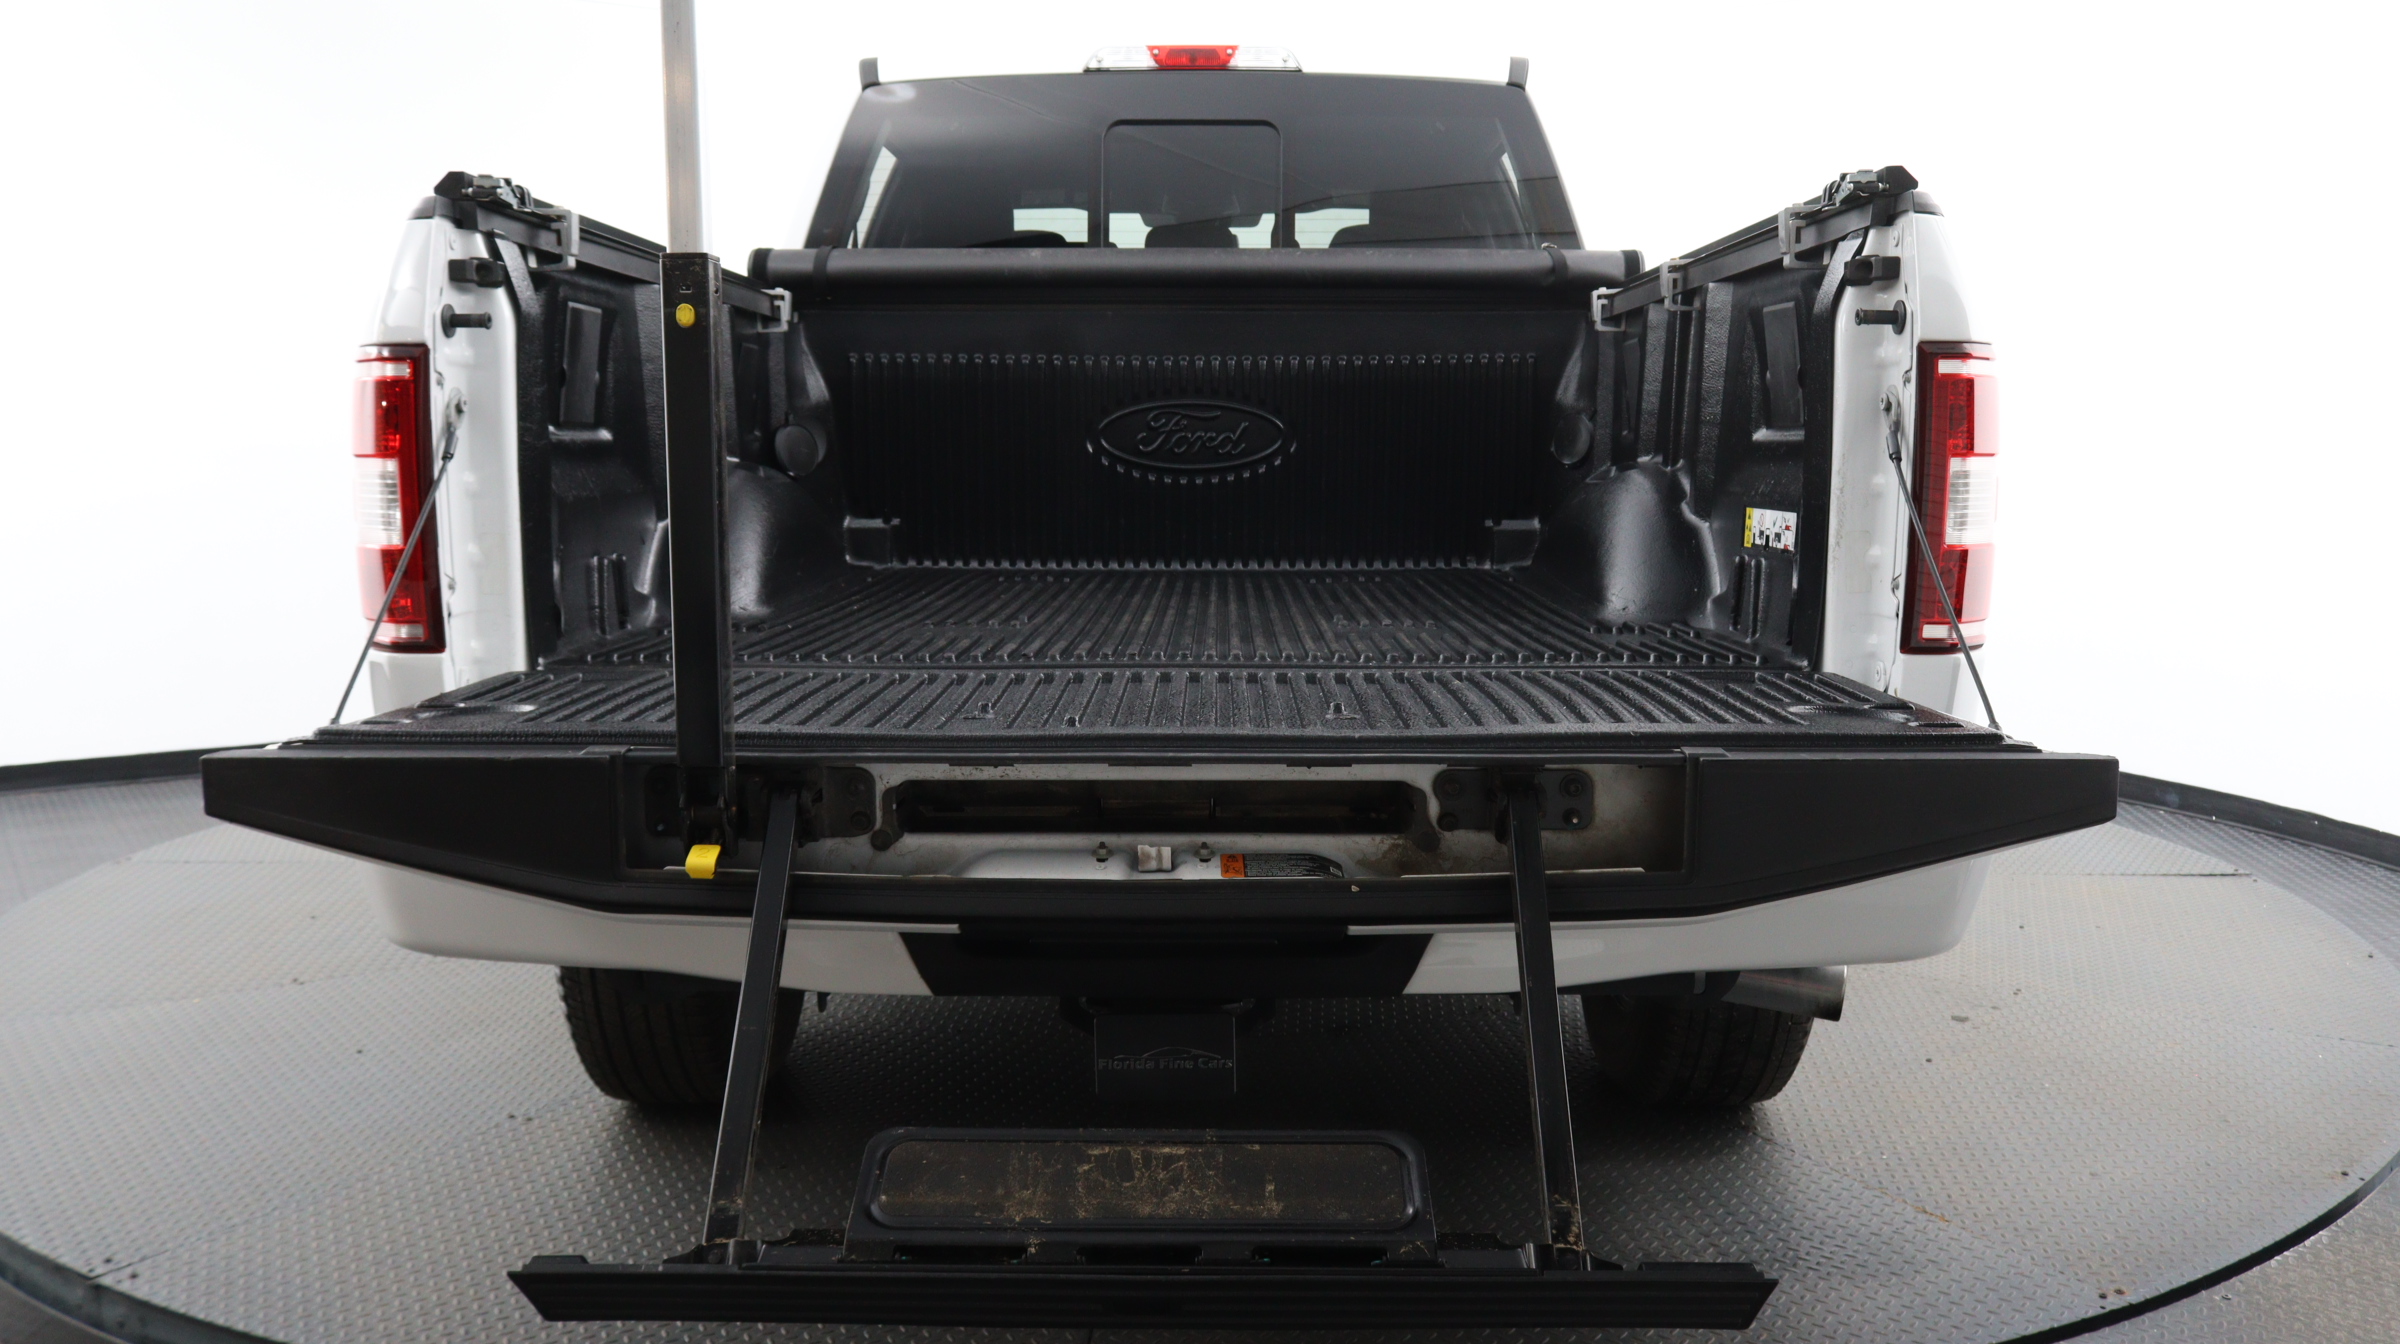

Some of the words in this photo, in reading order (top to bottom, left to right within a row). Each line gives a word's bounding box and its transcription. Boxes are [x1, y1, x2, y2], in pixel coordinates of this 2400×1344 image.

[1137, 409, 1249, 455] Ford
[696, 847, 710, 859] 2
[1097, 1058, 1155, 1070] Florida
[1159, 1058, 1194, 1070] Fine
[1197, 1057, 1233, 1069] Cars
